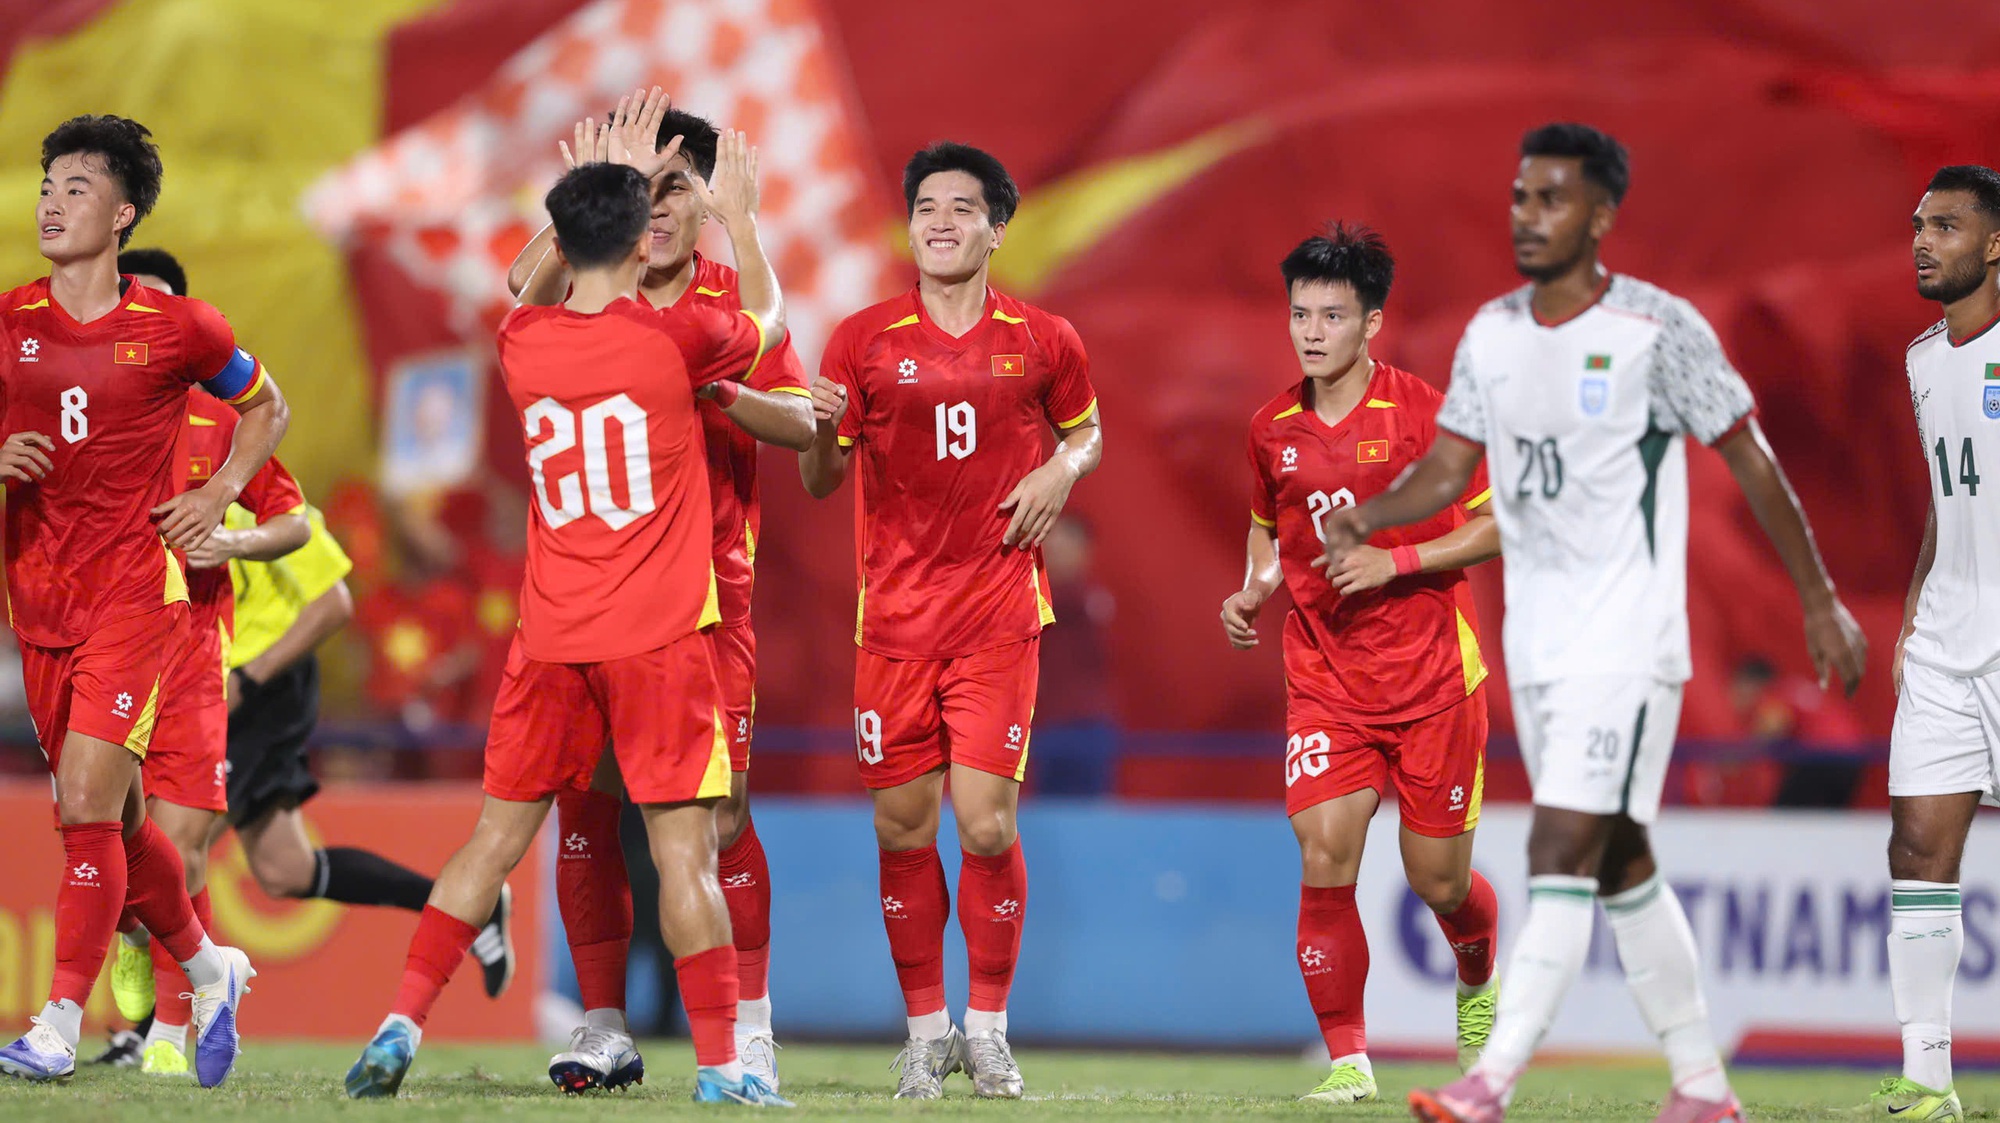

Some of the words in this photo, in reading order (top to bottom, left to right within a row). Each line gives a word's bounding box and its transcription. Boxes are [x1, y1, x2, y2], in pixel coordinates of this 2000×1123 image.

[61, 386, 88, 444] 8
[935, 400, 976, 461] 19
[523, 392, 656, 531] 20
[1514, 436, 1563, 499] 20
[1935, 437, 1980, 496] 14
[855, 707, 884, 765] 19
[1285, 731, 1331, 788] 22
[1585, 727, 1619, 761] 20
